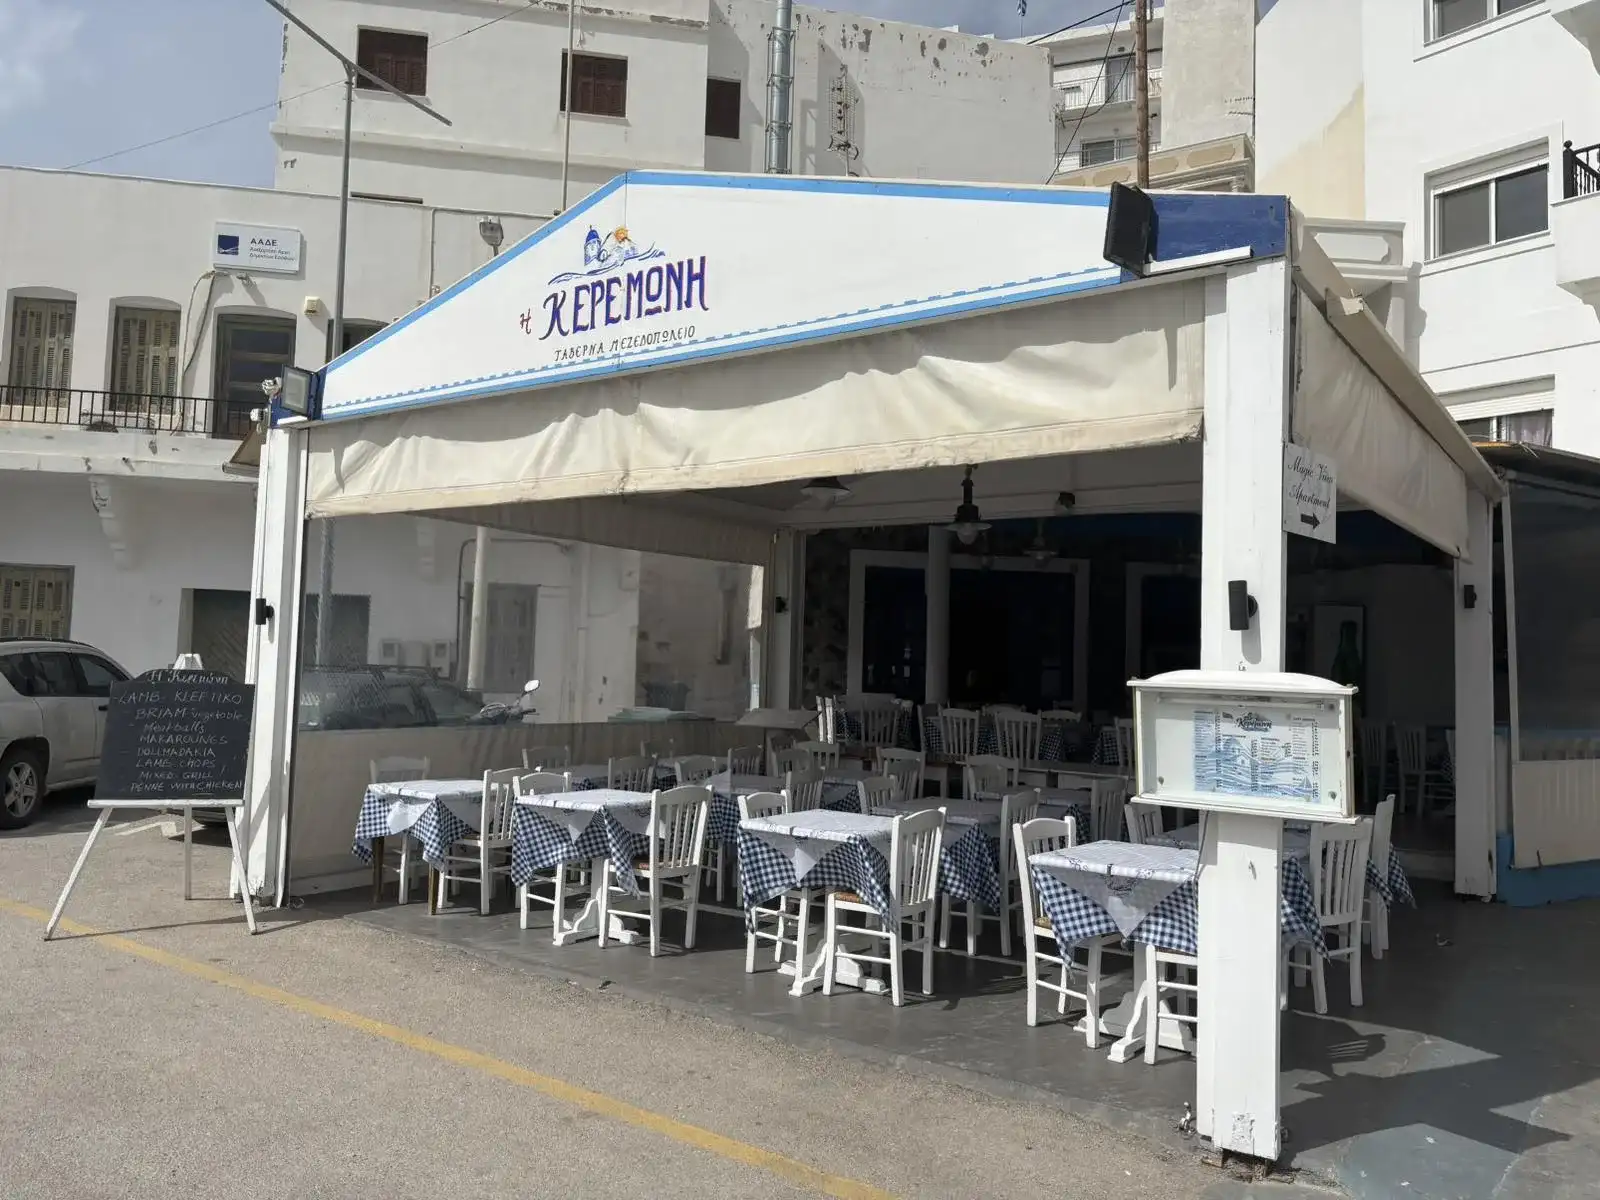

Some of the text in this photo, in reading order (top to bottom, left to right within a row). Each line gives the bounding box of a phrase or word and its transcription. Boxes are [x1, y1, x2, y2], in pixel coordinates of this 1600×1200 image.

[250, 238, 278, 246] ΑΑΔΕ
[538, 255, 709, 341] ΚΕΡΕΜΩΝΗ
[554, 325, 696, 362] ΤΑΒΕΡΝΑ ΜΕΖΕΔΟΠΩΛΕΙΟ
[135, 707, 187, 720] BRIAM
[180, 759, 216, 768] CHOPS
[140, 771, 213, 780] MIXED GRILL
[131, 782, 165, 792] PENNE
